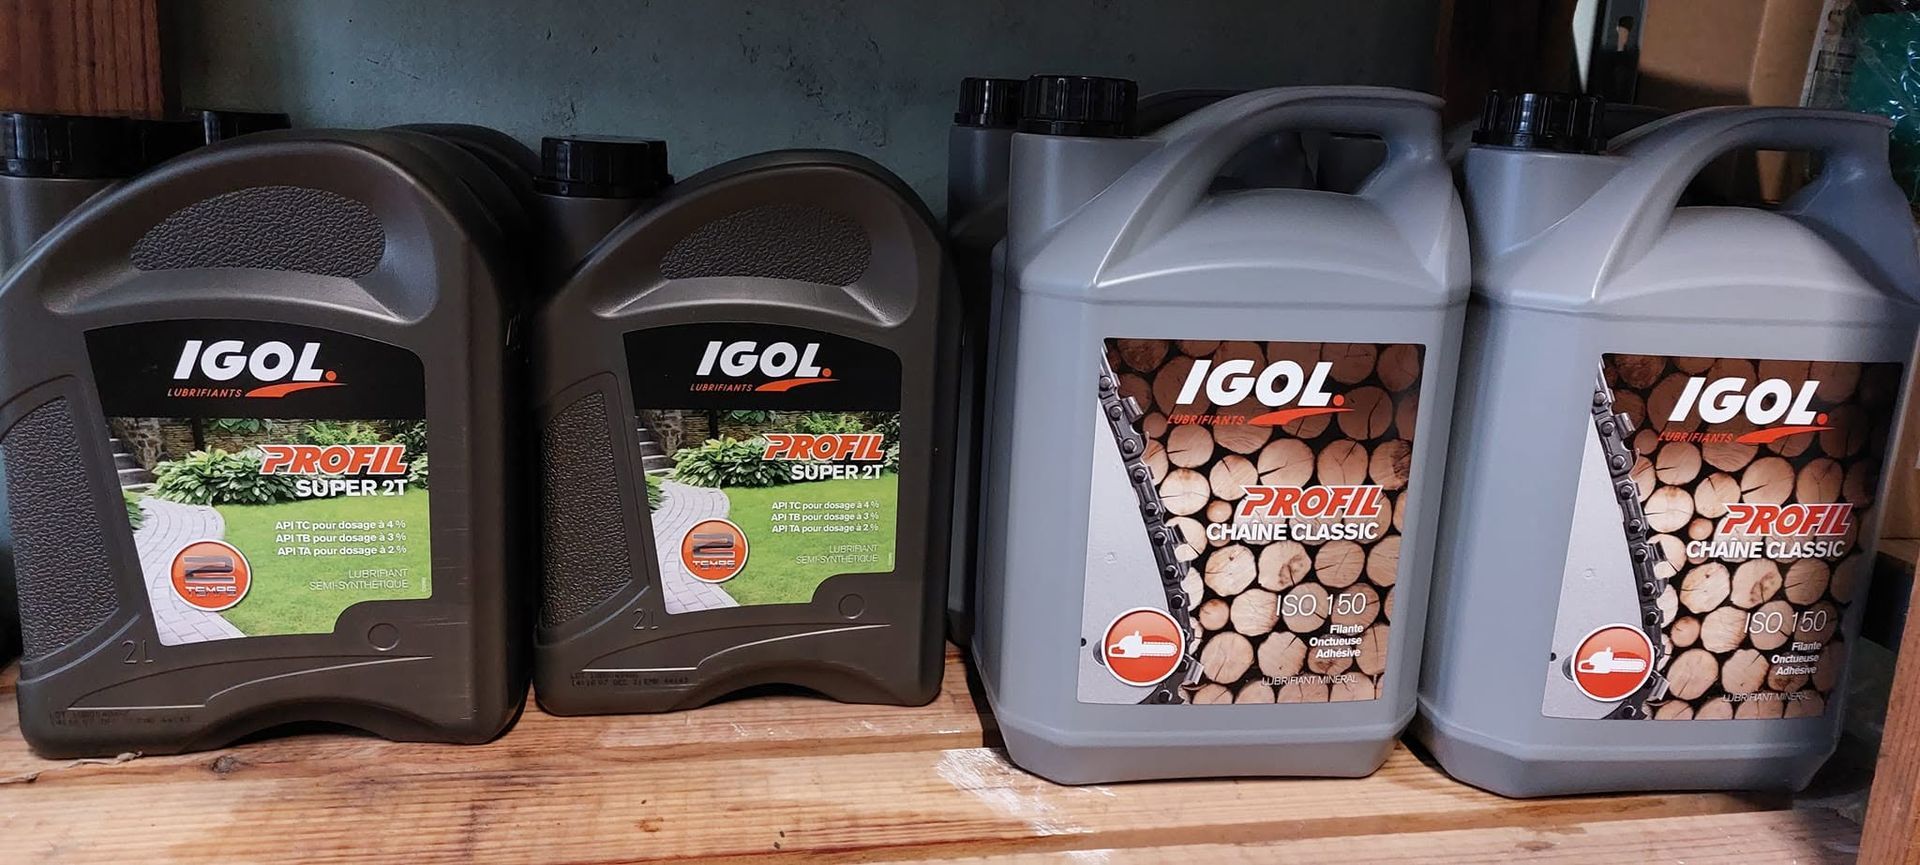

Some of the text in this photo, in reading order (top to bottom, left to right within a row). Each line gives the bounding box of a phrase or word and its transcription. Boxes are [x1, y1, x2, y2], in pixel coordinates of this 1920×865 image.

[167, 388, 242, 398] LUBRIFIANTS
[690, 383, 753, 392] LUBRIFIANTS
[1167, 415, 1245, 425] LUBRIFIANTS
[1658, 431, 1734, 444] LUBRIFIANTS
[762, 433, 885, 461] PROFIL
[257, 444, 408, 475] PROFIL
[791, 464, 884, 481] SUPER 2T
[296, 479, 408, 497] SUPER 2T
[771, 500, 879, 511] API TC pour dosage à 4 %
[1240, 485, 1384, 519] PROFIL
[771, 511, 879, 521] API TB pour dosage à 3 %
[1721, 502, 1853, 537] PROFIL
[275, 520, 406, 531] API TC pour dosage à 4 %
[771, 522, 879, 533] API TA pour dosage à 2 %
[1206, 521, 1379, 541] CHAÎNE CLASSIC
[276, 532, 406, 544] API TB pour dosage à 3 %
[277, 545, 407, 557] API TA pour dosage à 2 %
[829, 545, 879, 554] LUBRIFIANT
[1686, 537, 1845, 559] CHAÎNE CLASSIC
[348, 569, 408, 579] LUBRIFIANT
[1276, 592, 1367, 617] ISO 150
[1744, 610, 1827, 634] ISO 150
[1330, 624, 1364, 634] Filante
[1308, 636, 1363, 647] Onctueuse
[1791, 641, 1822, 652] Filante
[1316, 647, 1361, 659] Adhésive
[1771, 653, 1819, 664] Onctueuse
[1261, 676, 1316, 686] LUBRIFIANT
[1722, 692, 1773, 702] LUBRIFIANT
